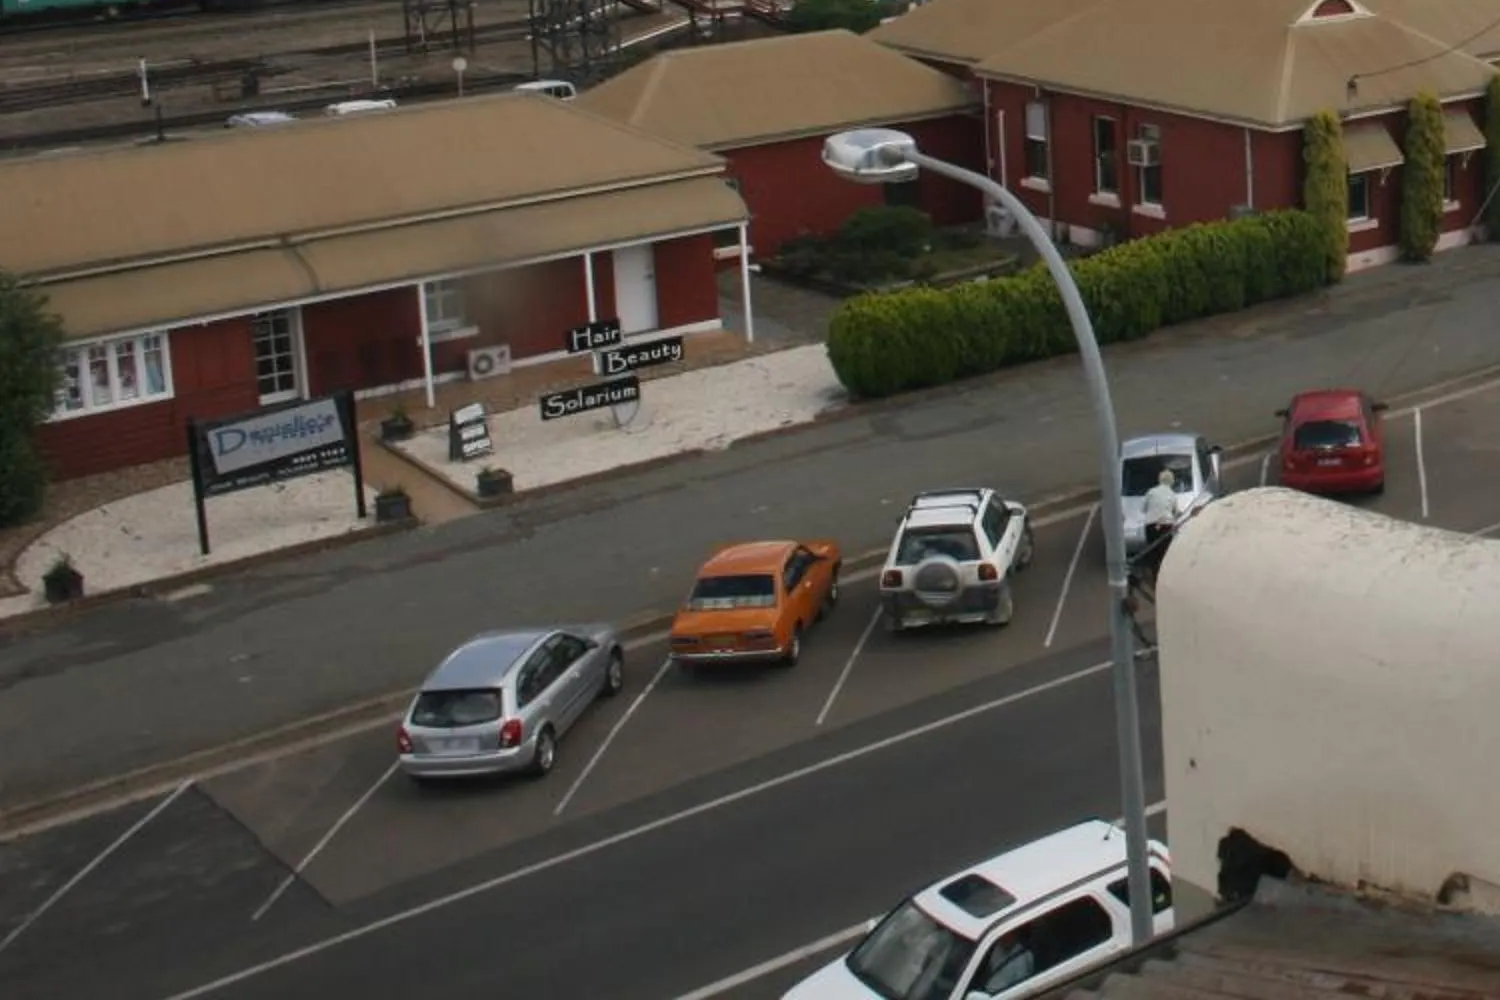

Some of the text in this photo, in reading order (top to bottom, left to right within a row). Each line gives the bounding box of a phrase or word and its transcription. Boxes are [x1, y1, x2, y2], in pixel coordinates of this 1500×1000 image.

[572, 326, 619, 350] Hair
[607, 343, 682, 373] Beauty
[545, 386, 637, 417] Solarium
